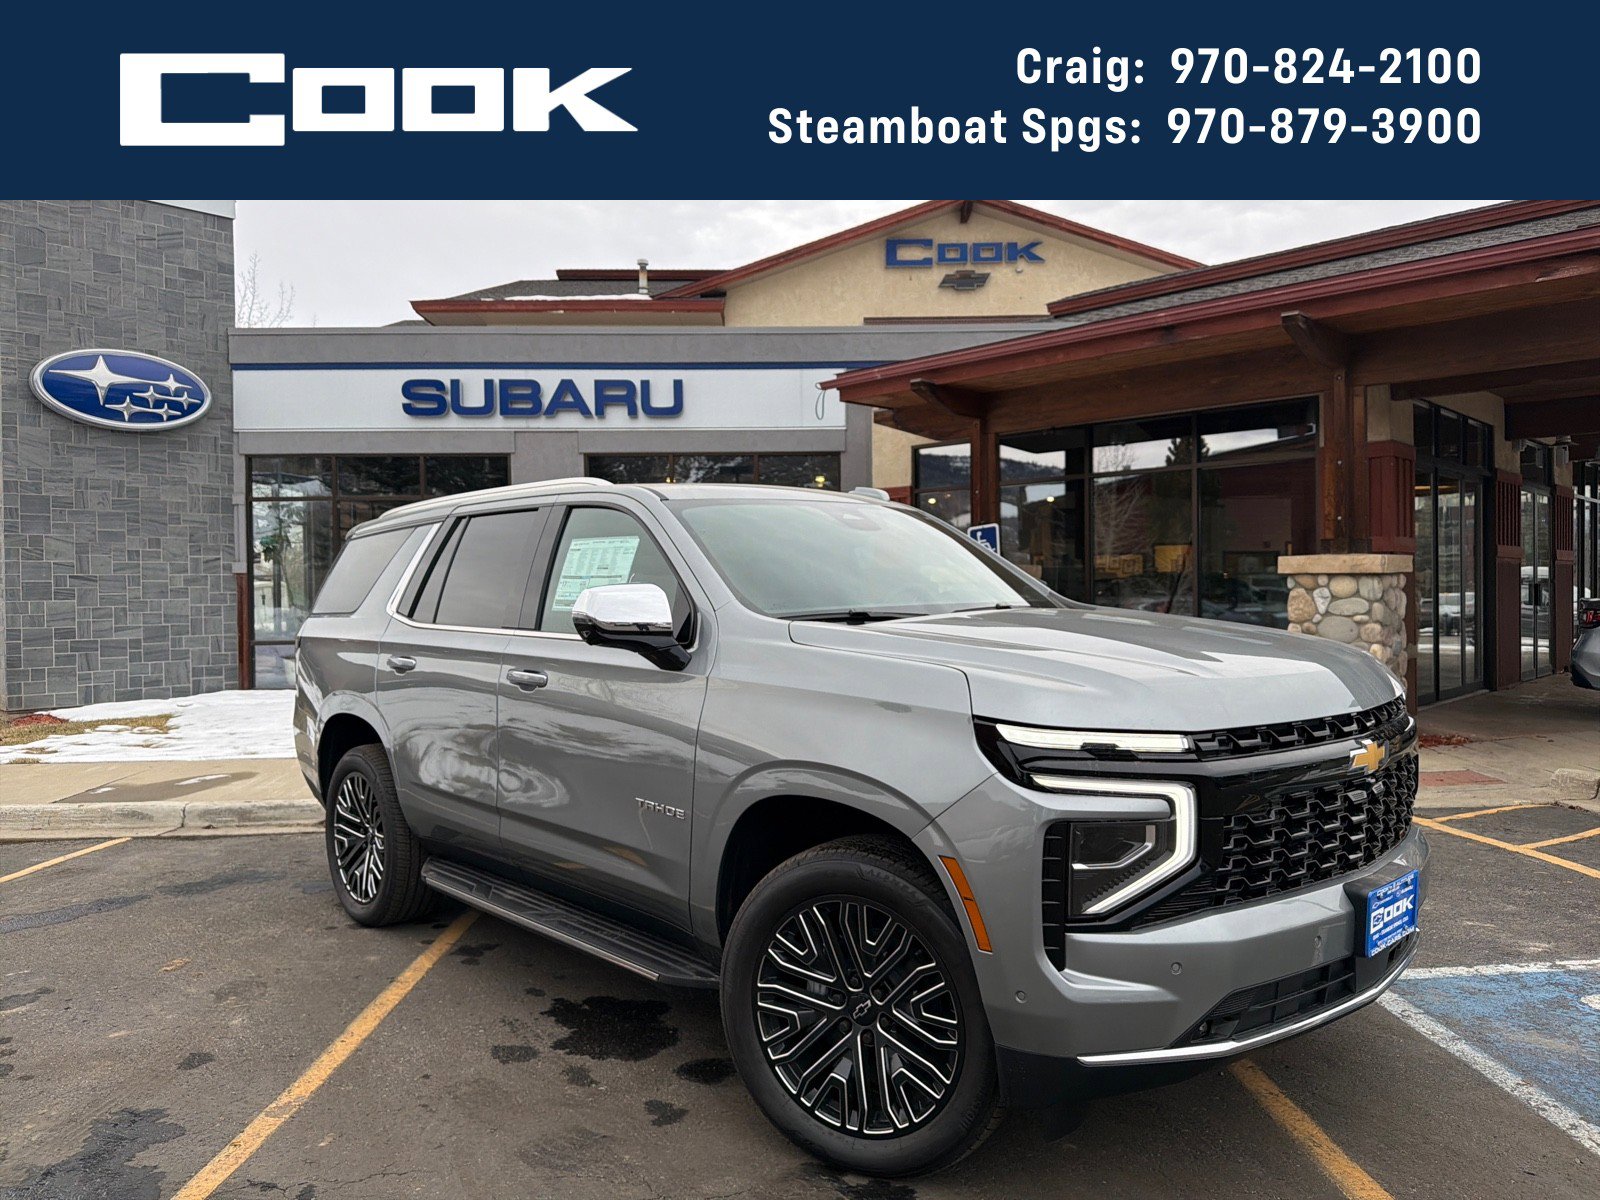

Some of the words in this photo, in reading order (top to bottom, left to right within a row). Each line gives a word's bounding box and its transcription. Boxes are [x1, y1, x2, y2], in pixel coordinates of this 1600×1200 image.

[885, 238, 1045, 268] COOK
[401, 378, 684, 418] SUBARU
[635, 797, 685, 819] TAHOE
[1370, 893, 1415, 934] COOK
